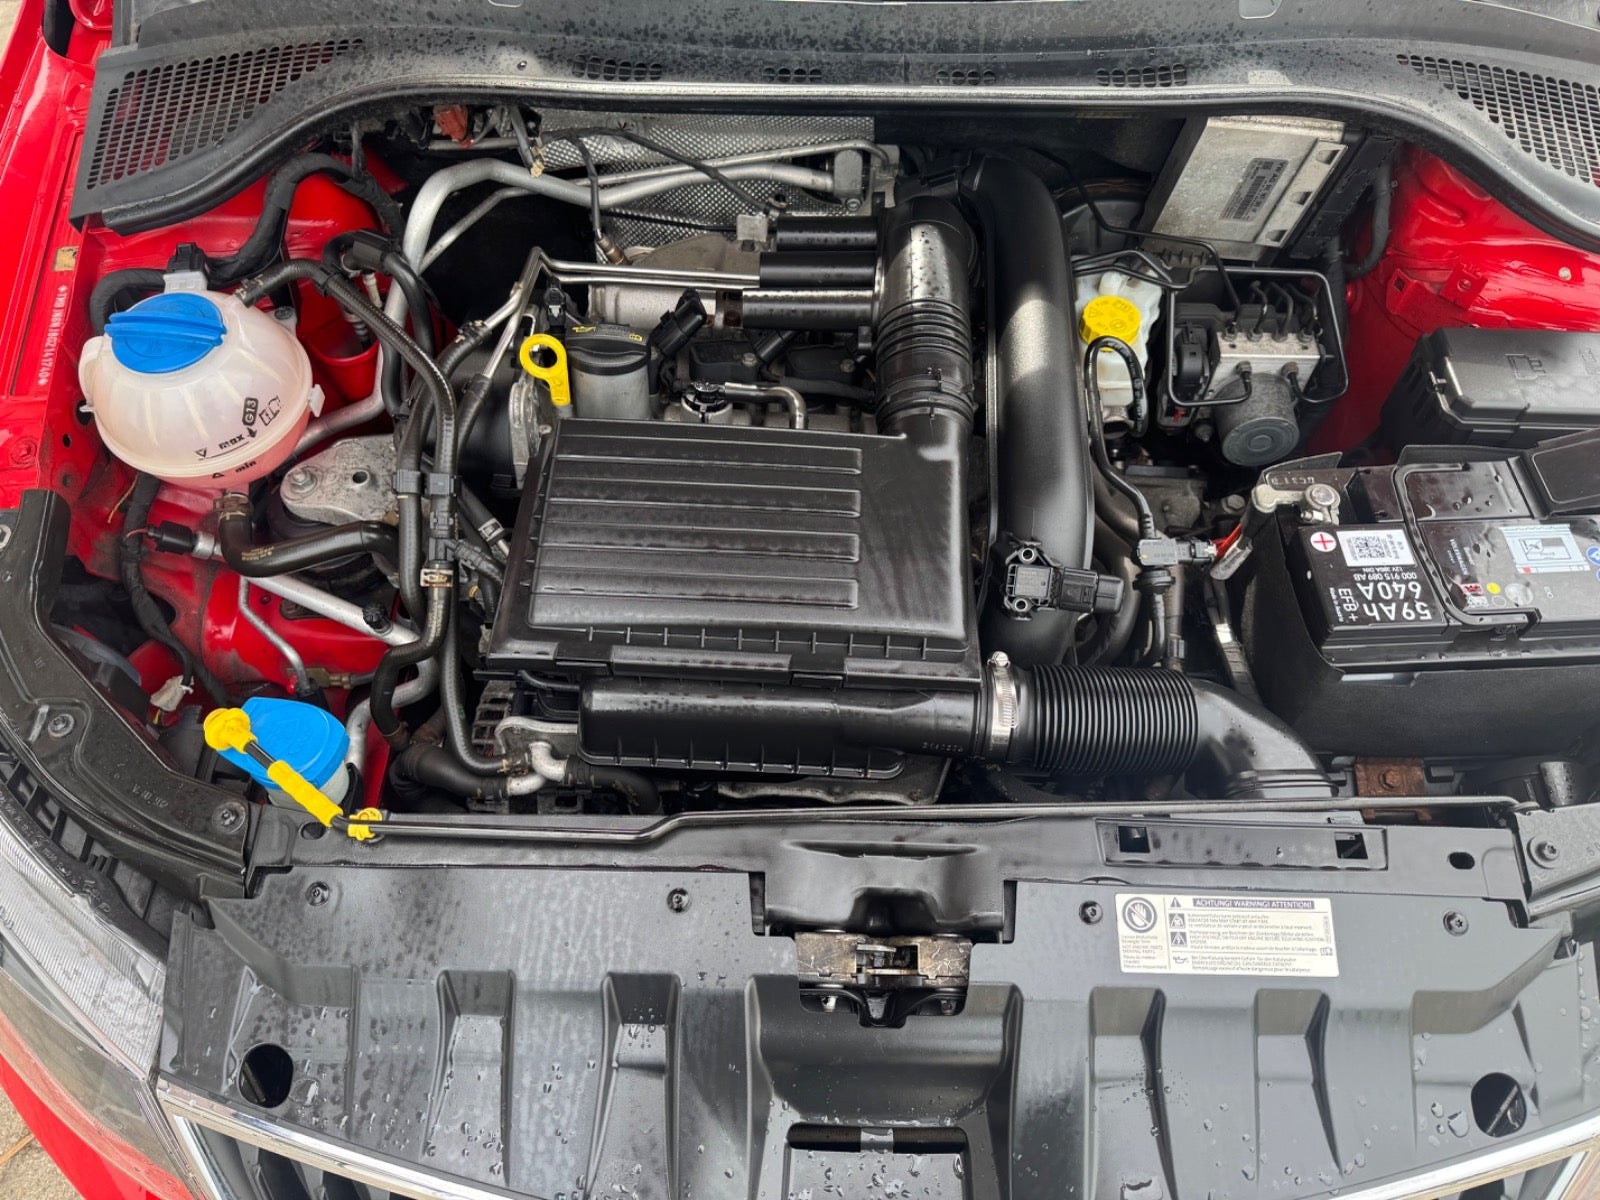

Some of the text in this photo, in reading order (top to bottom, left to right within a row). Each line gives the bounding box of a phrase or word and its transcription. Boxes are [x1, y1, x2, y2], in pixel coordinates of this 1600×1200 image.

[244, 400, 257, 423] G13
[218, 434, 245, 450] max
[235, 460, 257, 473] min
[1353, 572, 1418, 581] 000 915 089 AB
[1356, 581, 1422, 601] 640A
[1362, 600, 1433, 621] 59Ah
[1195, 900, 1313, 910] ACHTUNG! WARNING! ATTENTION!
